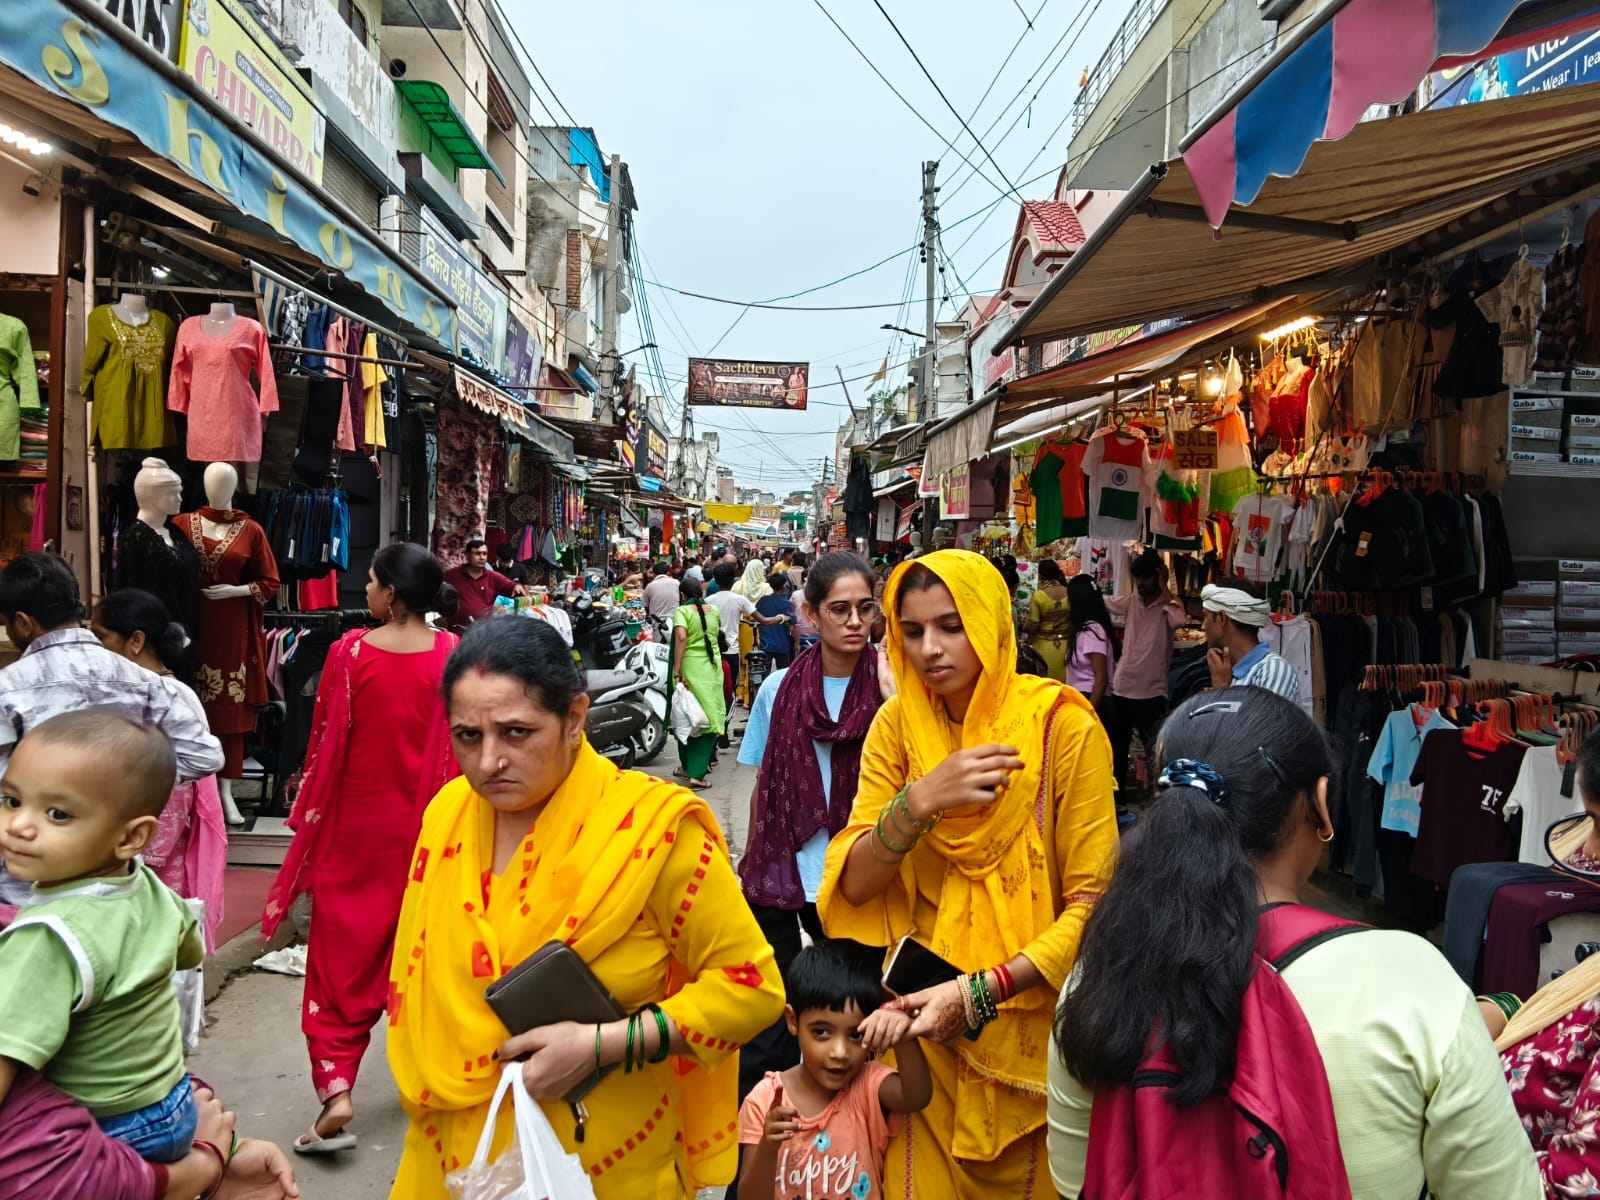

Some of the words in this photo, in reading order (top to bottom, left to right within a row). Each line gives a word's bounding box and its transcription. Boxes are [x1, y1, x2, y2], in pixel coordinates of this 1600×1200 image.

[1542, 68, 1570, 91] Wear
[714, 361, 775, 375] Sachdeva
[1575, 368, 1596, 377] Gaba
[1513, 400, 1536, 408] Gaba
[1574, 416, 1596, 424] Gaba
[1511, 426, 1534, 434] Gaba
[1176, 432, 1217, 448] SALE
[1176, 448, 1215, 469] सेल
[1513, 453, 1535, 461] Gaba
[1561, 561, 1584, 569] Gaba
